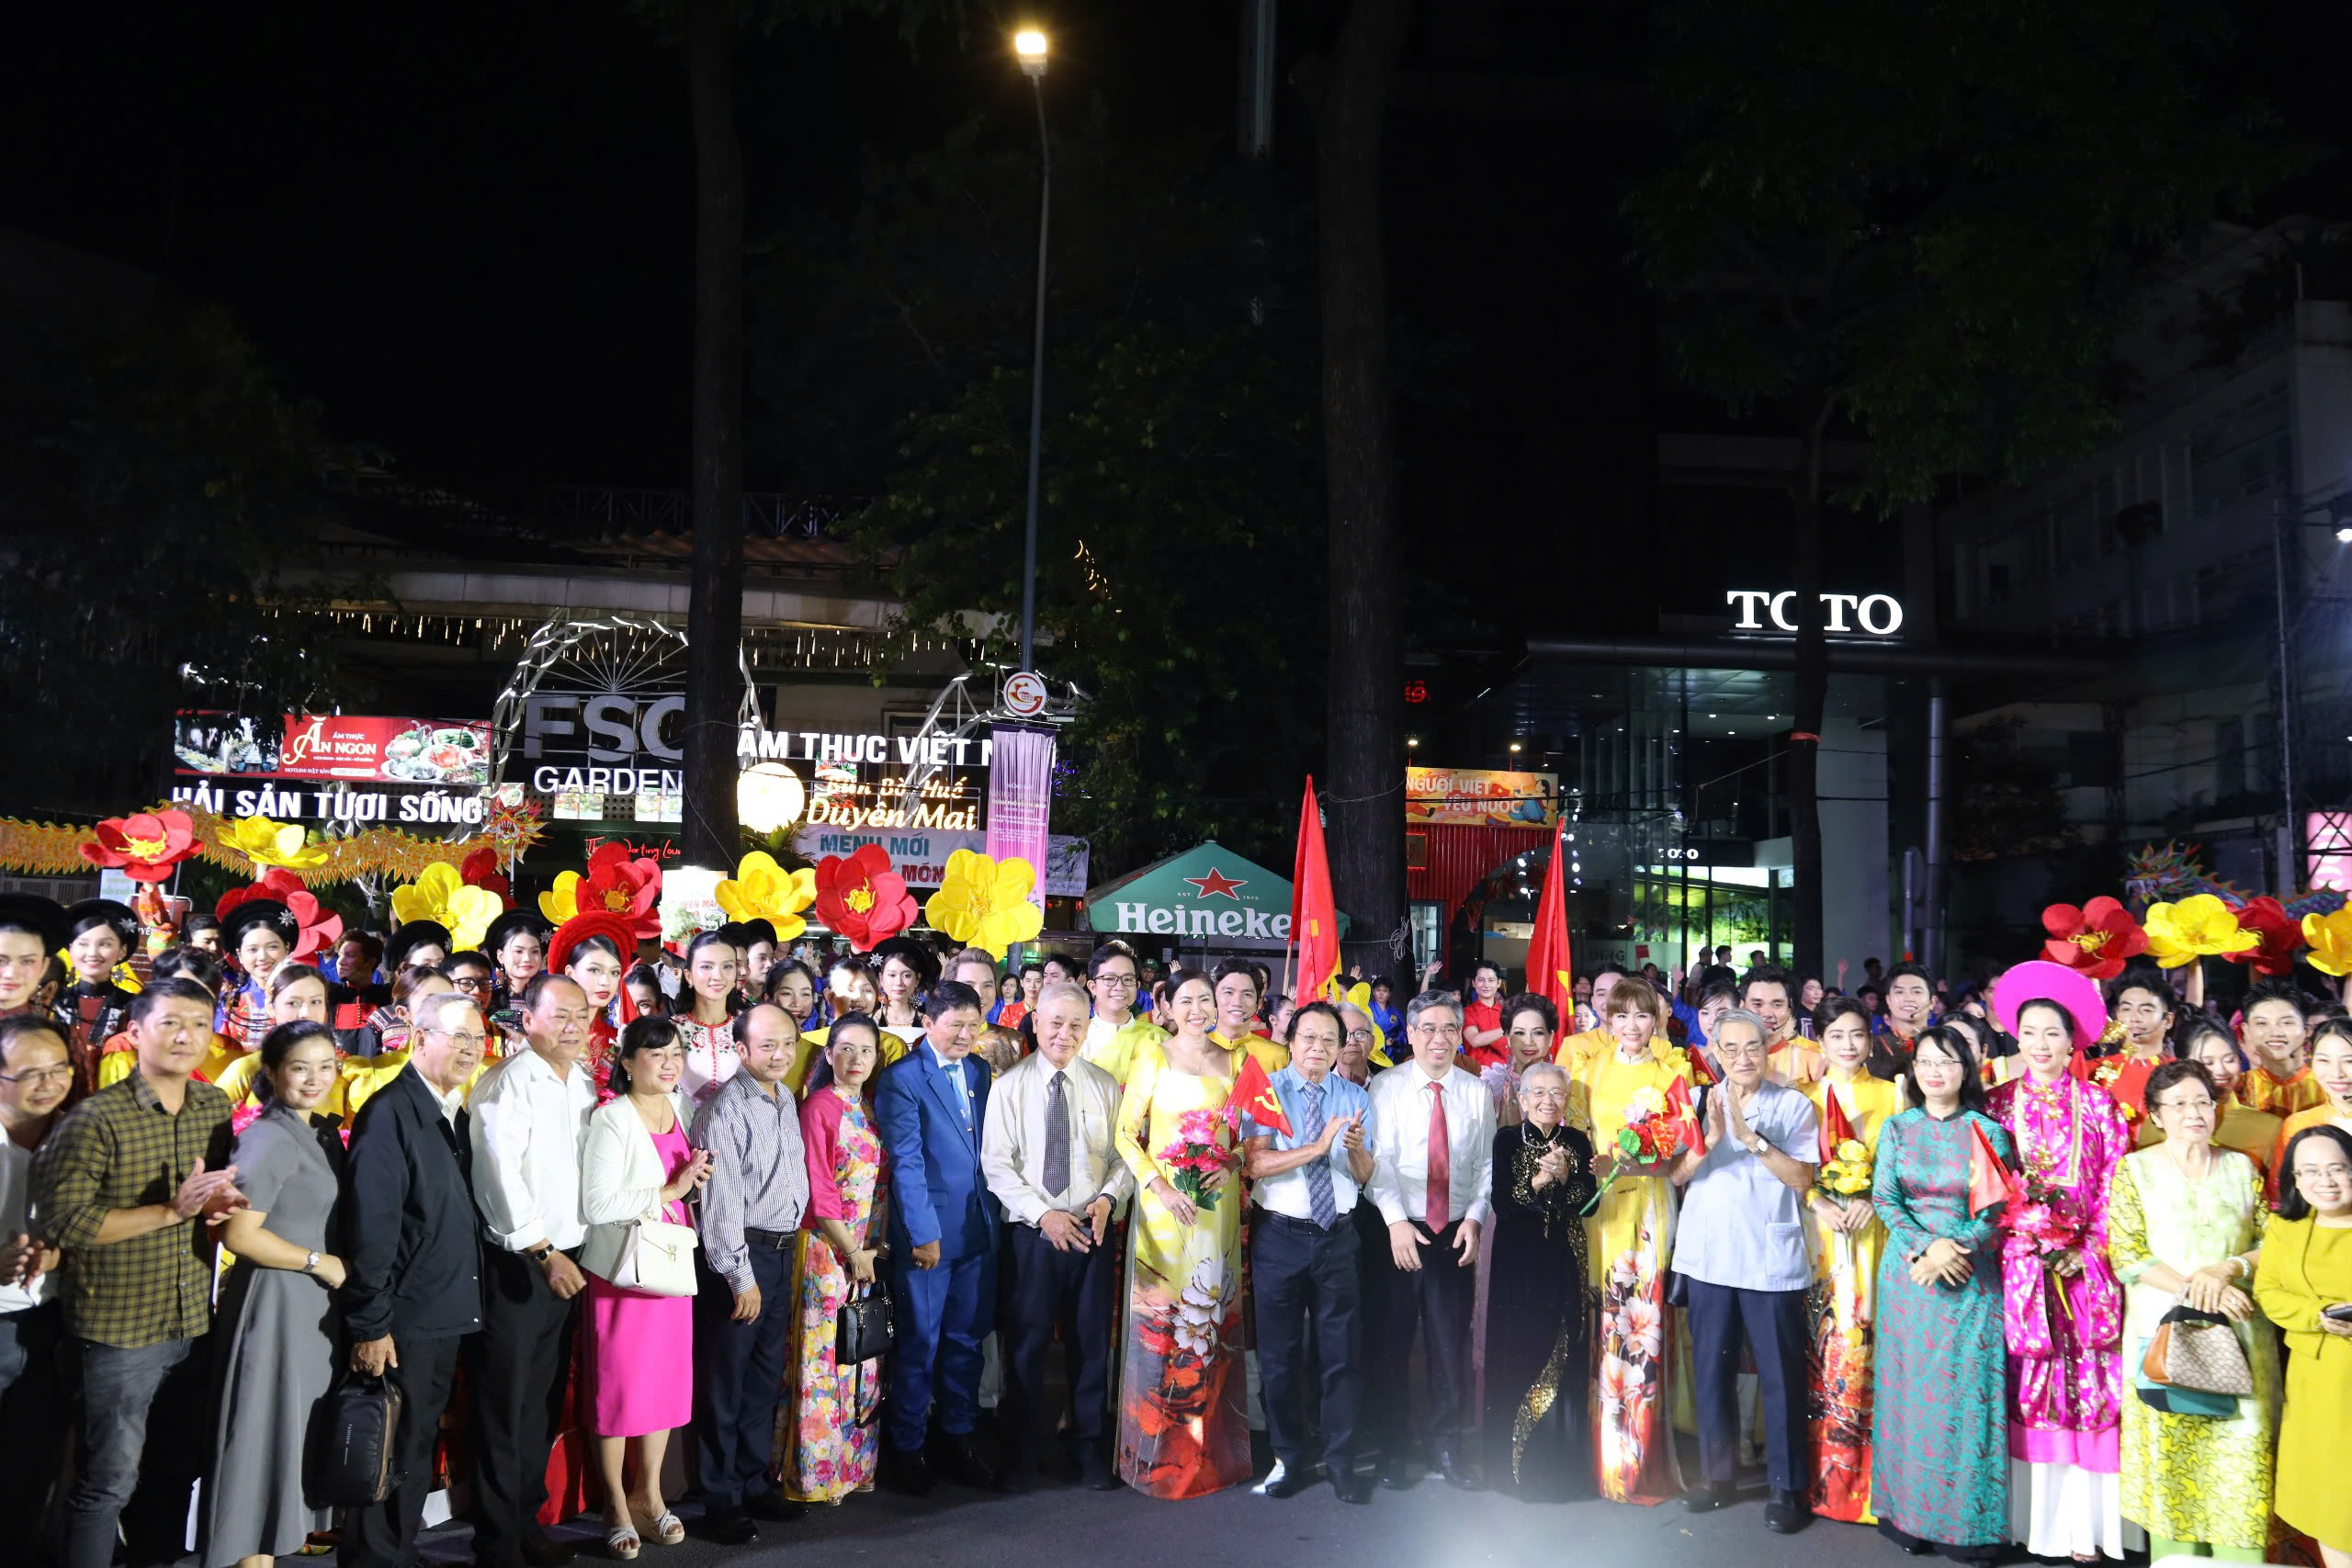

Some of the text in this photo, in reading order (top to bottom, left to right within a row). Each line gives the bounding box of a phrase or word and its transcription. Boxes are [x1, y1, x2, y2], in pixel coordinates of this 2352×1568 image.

[334, 743, 377, 754] NGON
[898, 731, 970, 771] VIỆT
[534, 766, 684, 795] GARDEN
[921, 777, 967, 799] Huế
[1459, 777, 1491, 796] VIỆT
[235, 783, 301, 818] SẢN
[313, 790, 387, 820] TƯƠI
[399, 789, 482, 824] SỐNG
[808, 798, 977, 831] Duyên Mai
[1443, 794, 1472, 811] YÊU
[889, 833, 929, 856] MỚI
[1115, 902, 1292, 939] Heineke
